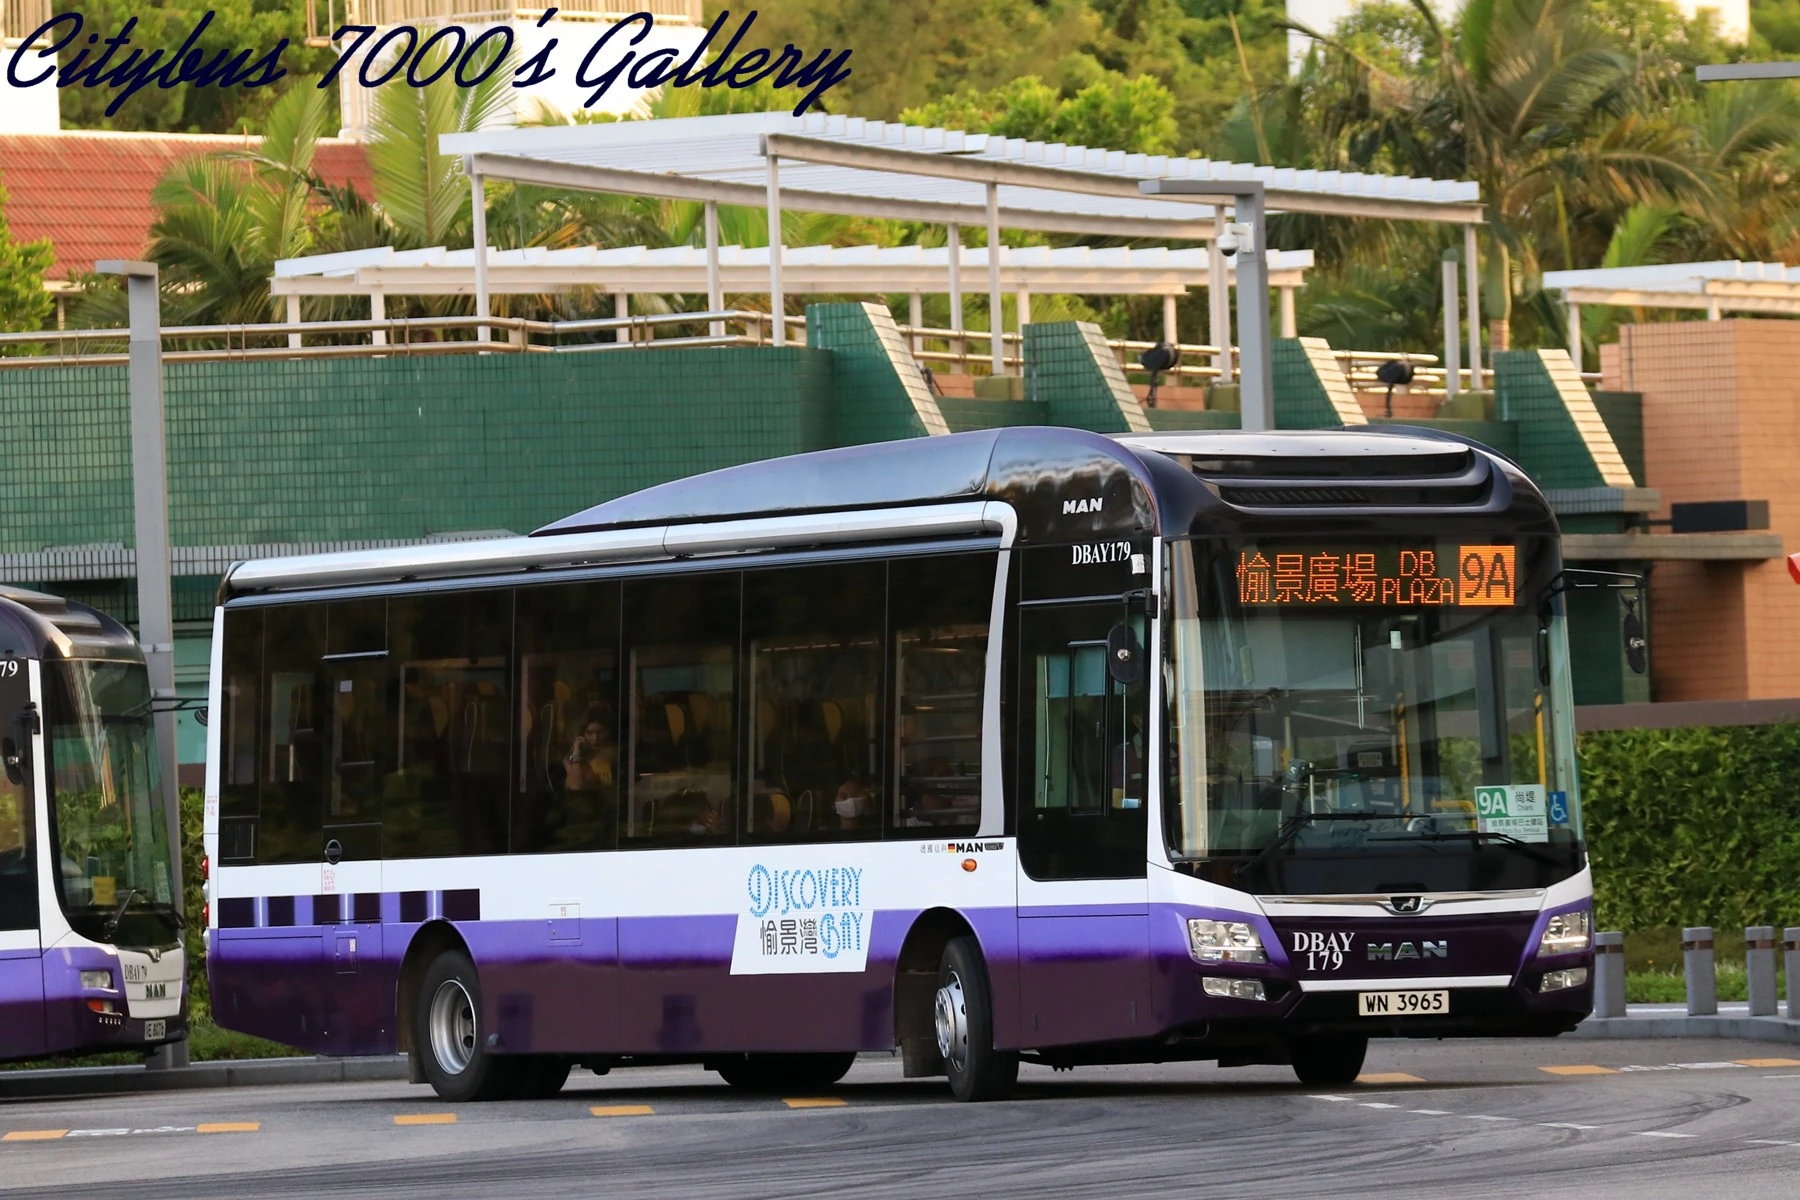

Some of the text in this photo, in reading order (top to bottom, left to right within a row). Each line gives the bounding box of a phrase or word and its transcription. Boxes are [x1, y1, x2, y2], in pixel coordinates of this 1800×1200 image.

[1062, 497, 1103, 515] MAN
[1071, 541, 1131, 566] DBAY179
[1400, 550, 1435, 577] DB
[1237, 551, 1378, 604] 愉景廣場
[1463, 552, 1511, 599] 9A
[1382, 577, 1455, 605] PLAZA
[0, 660, 18, 677] 79
[1479, 792, 1507, 815] 9A
[1515, 790, 1536, 804] 尚堤
[956, 842, 983, 853] MAN
[748, 863, 863, 918] DISCOVERY
[760, 918, 818, 955] 愉景灣
[819, 911, 863, 959] BAY
[1293, 931, 1356, 953] DBAY
[1306, 950, 1344, 971] 179
[1367, 940, 1448, 961] MAN
[145, 983, 166, 999] MAN
[1365, 993, 1443, 1013] WN 3965
